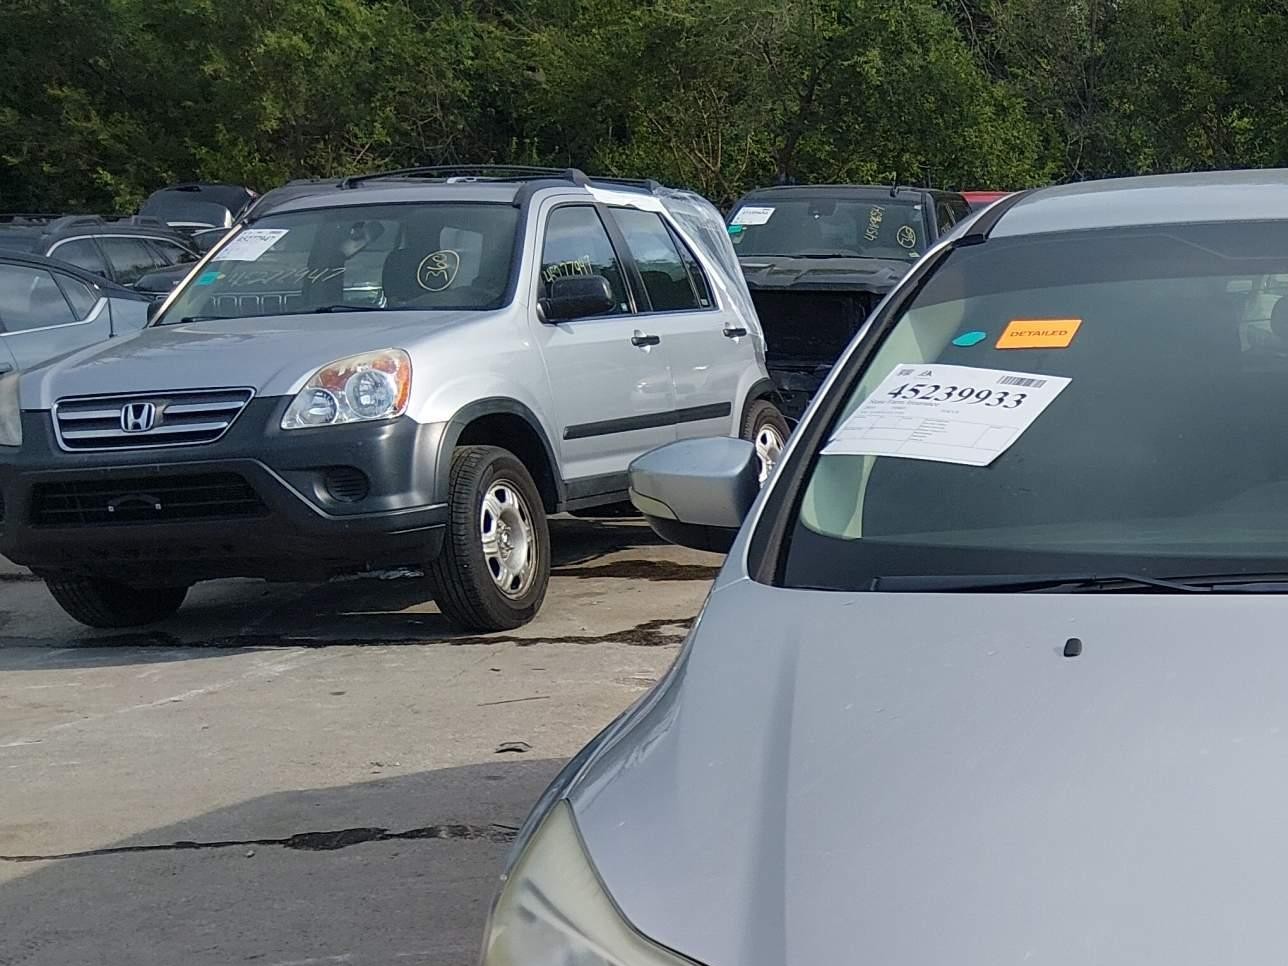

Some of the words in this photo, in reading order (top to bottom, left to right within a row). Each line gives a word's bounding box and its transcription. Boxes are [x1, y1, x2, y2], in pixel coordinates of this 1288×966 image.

[425, 252, 449, 282] 360
[1009, 329, 1068, 337] DETAILED
[887, 382, 1028, 409] 45239933
